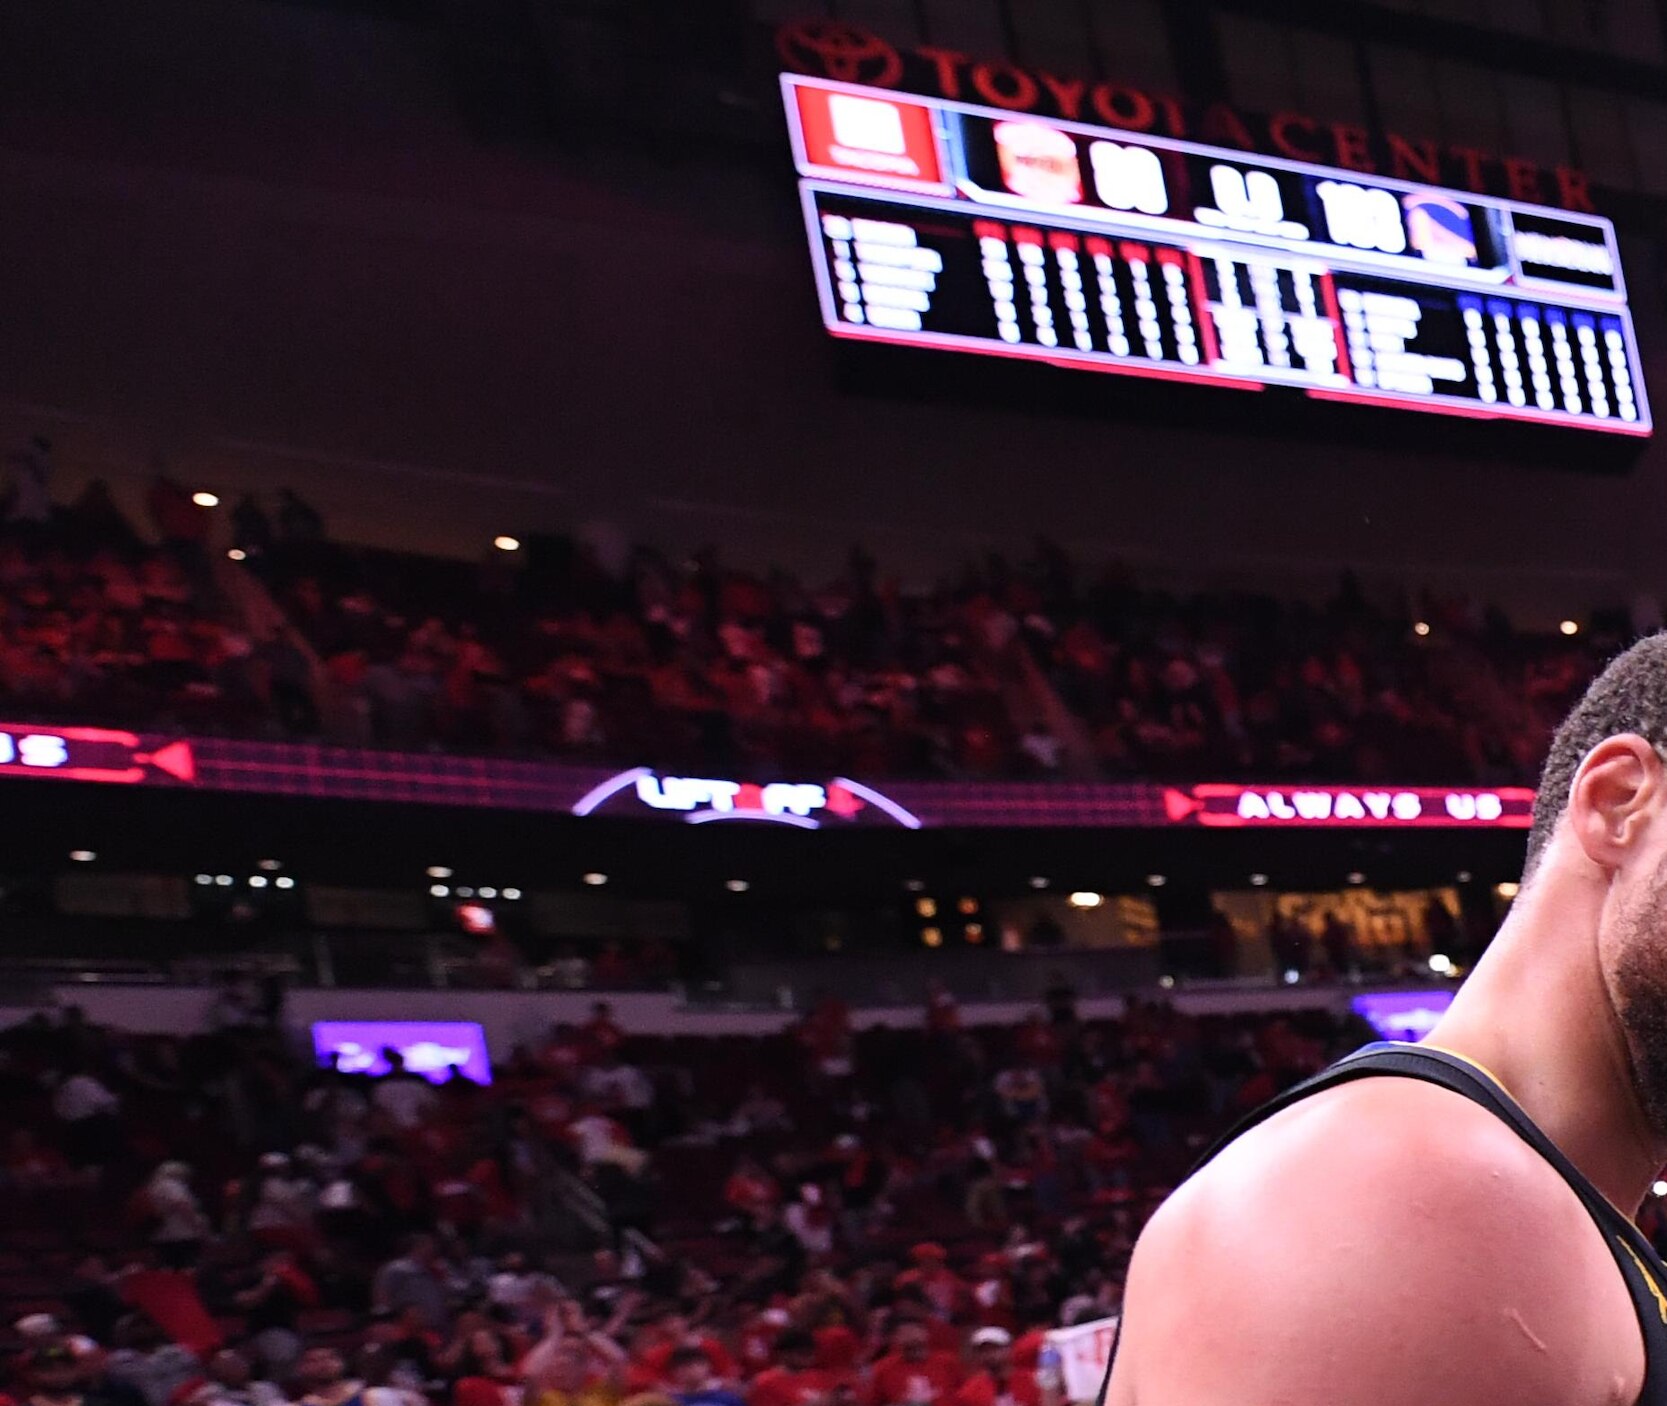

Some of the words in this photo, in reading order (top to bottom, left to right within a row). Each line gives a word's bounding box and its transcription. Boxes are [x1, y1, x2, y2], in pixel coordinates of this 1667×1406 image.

[913, 46, 1255, 151] TOYOTA
[1268, 112, 1597, 214] CENTER
[1237, 790, 1422, 820] ALWAYS
[1445, 792, 1503, 821] US
